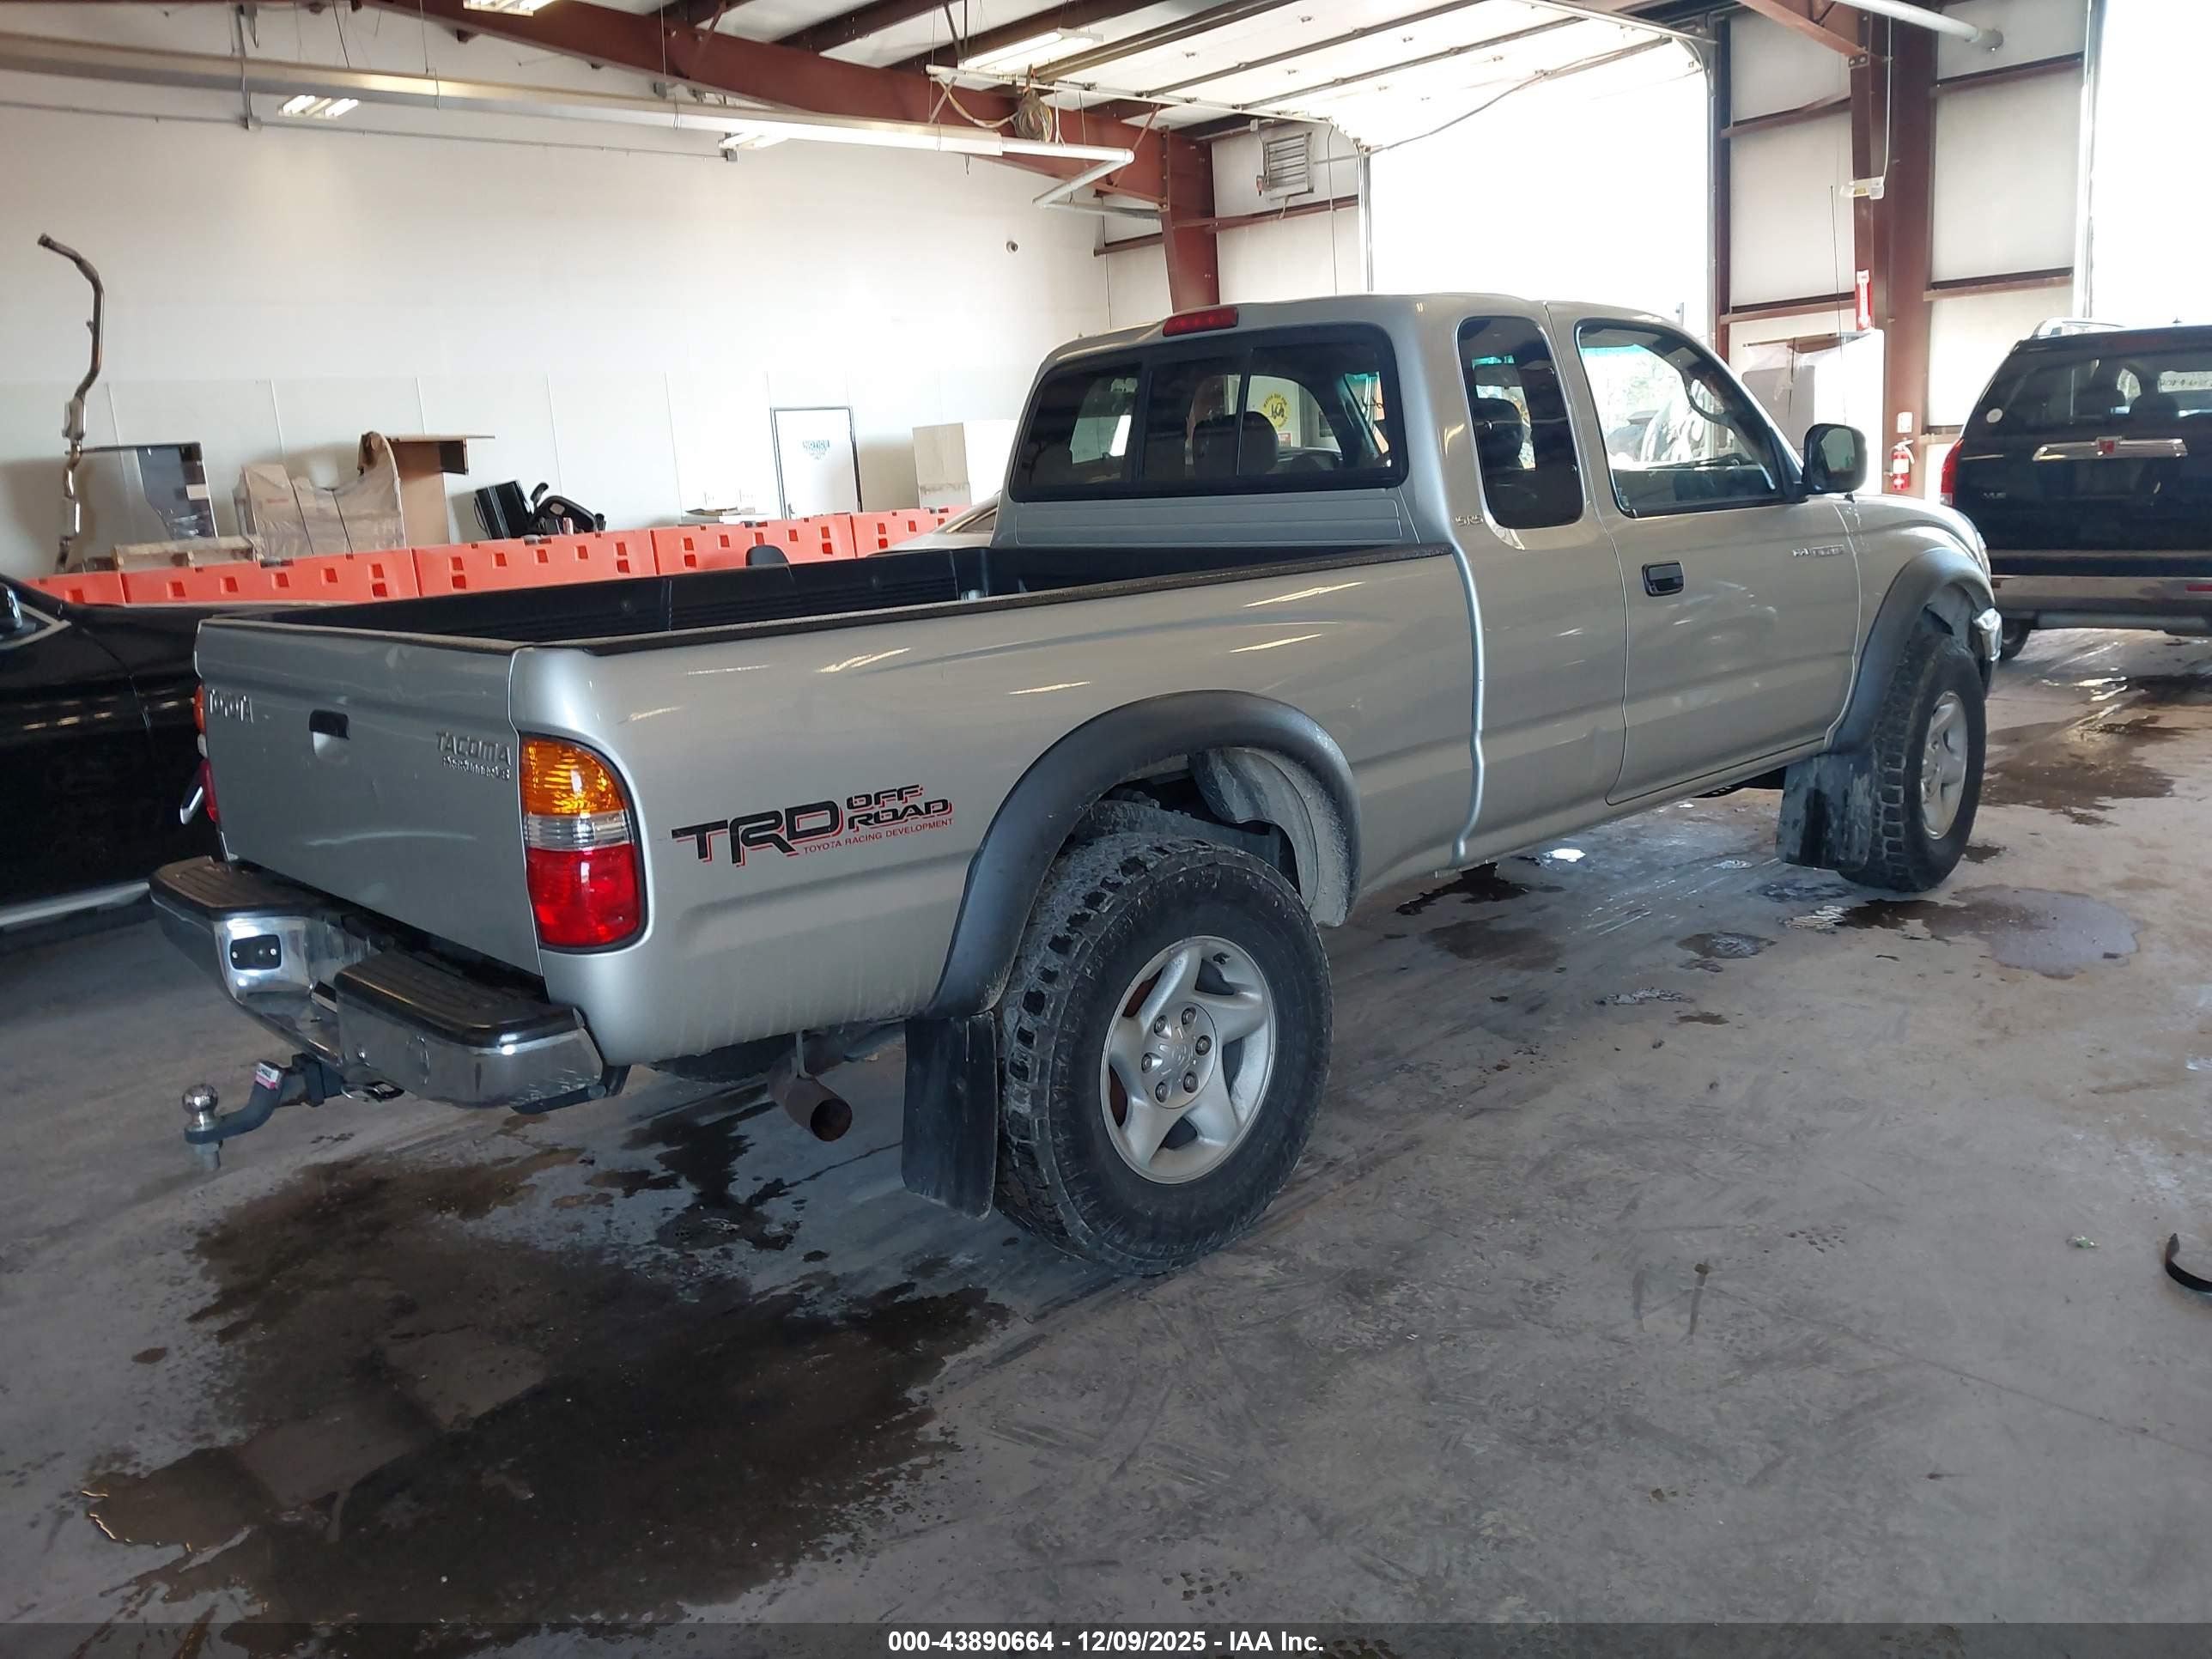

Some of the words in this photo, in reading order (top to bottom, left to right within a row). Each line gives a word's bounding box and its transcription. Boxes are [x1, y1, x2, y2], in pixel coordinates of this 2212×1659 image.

[436, 730, 511, 766] TACOMA
[846, 784, 924, 813] OFF
[848, 799, 953, 833] ROAD
[671, 800, 844, 868] TRD
[804, 840, 842, 854] TOYOTA
[845, 831, 883, 846] RACING
[885, 817, 954, 838] DEVELOPMENT
